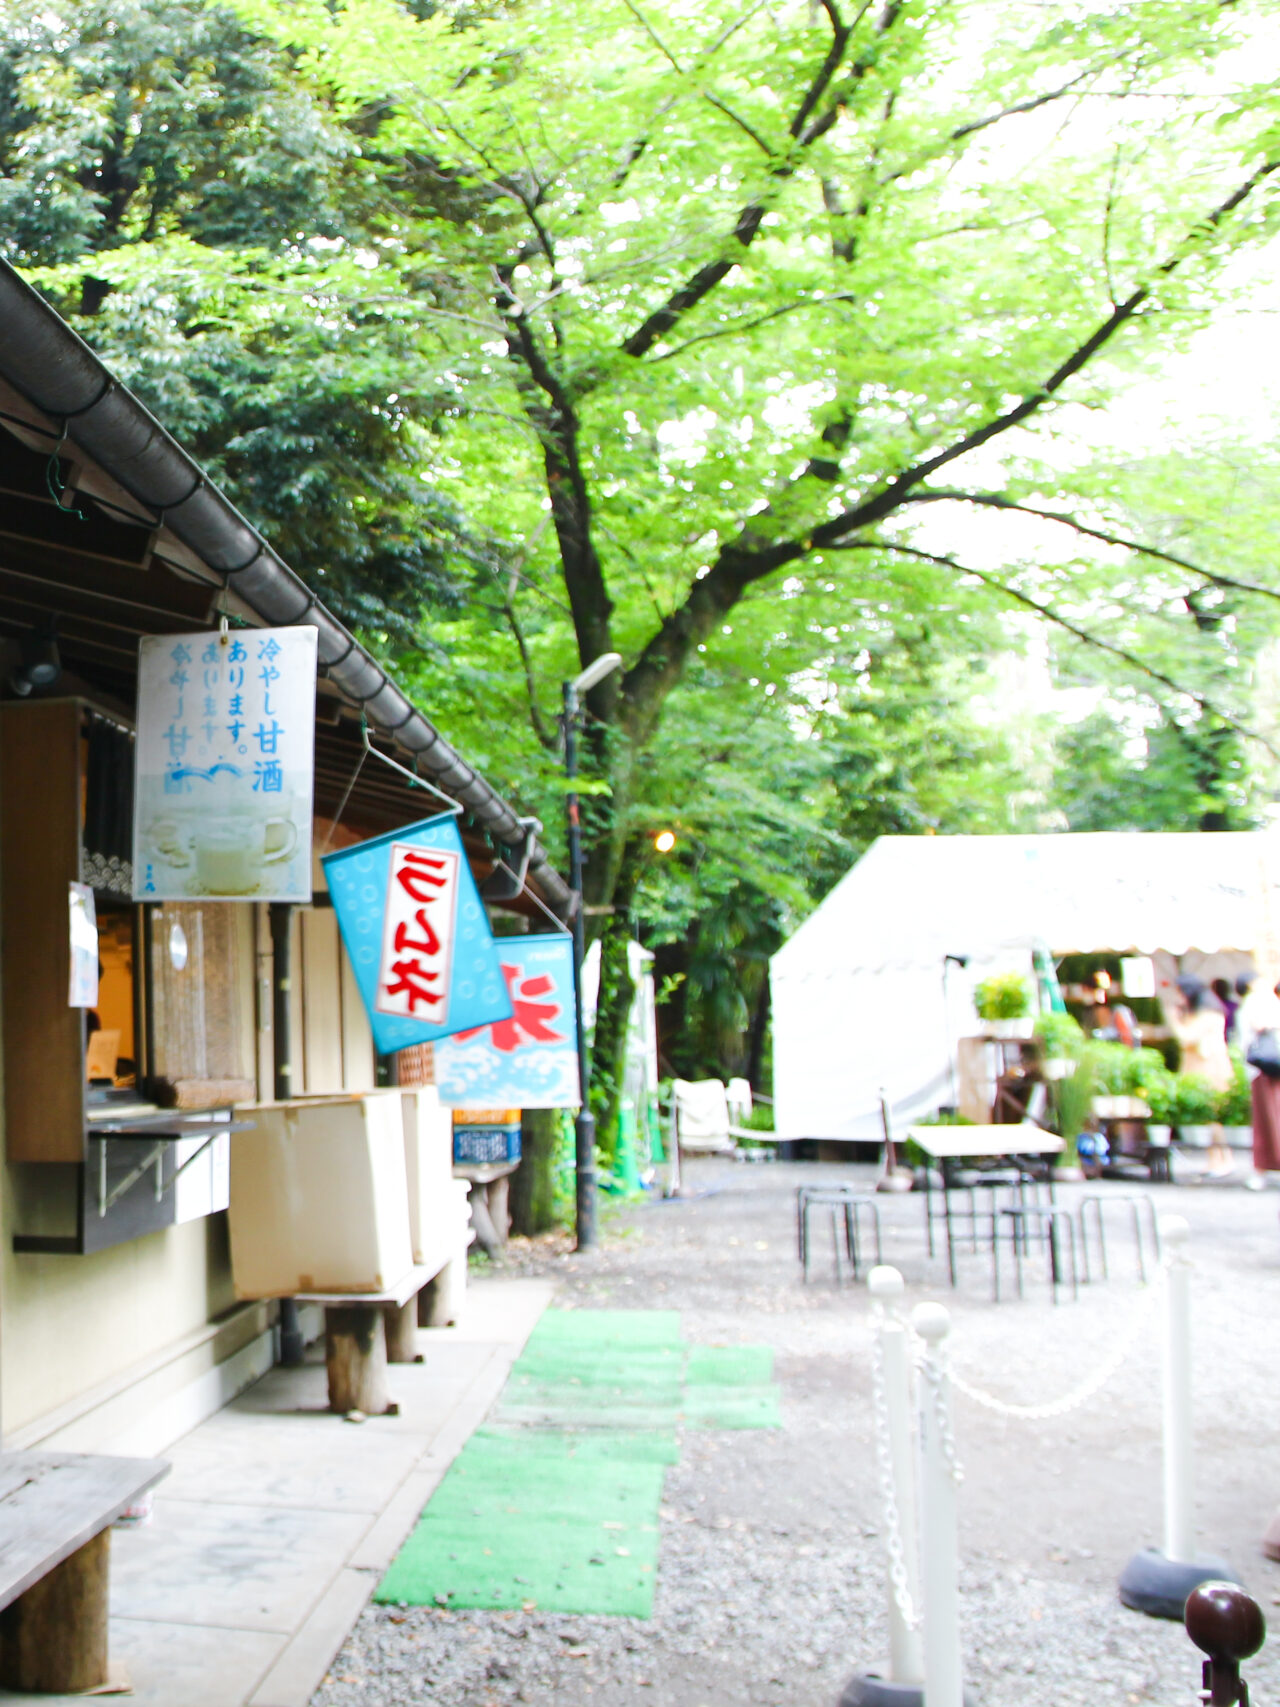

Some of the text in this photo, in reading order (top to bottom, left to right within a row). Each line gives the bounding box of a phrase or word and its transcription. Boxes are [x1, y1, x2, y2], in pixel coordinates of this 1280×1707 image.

[226, 639, 248, 755] あります。
[252, 637, 285, 793] 冷やし甘酒
